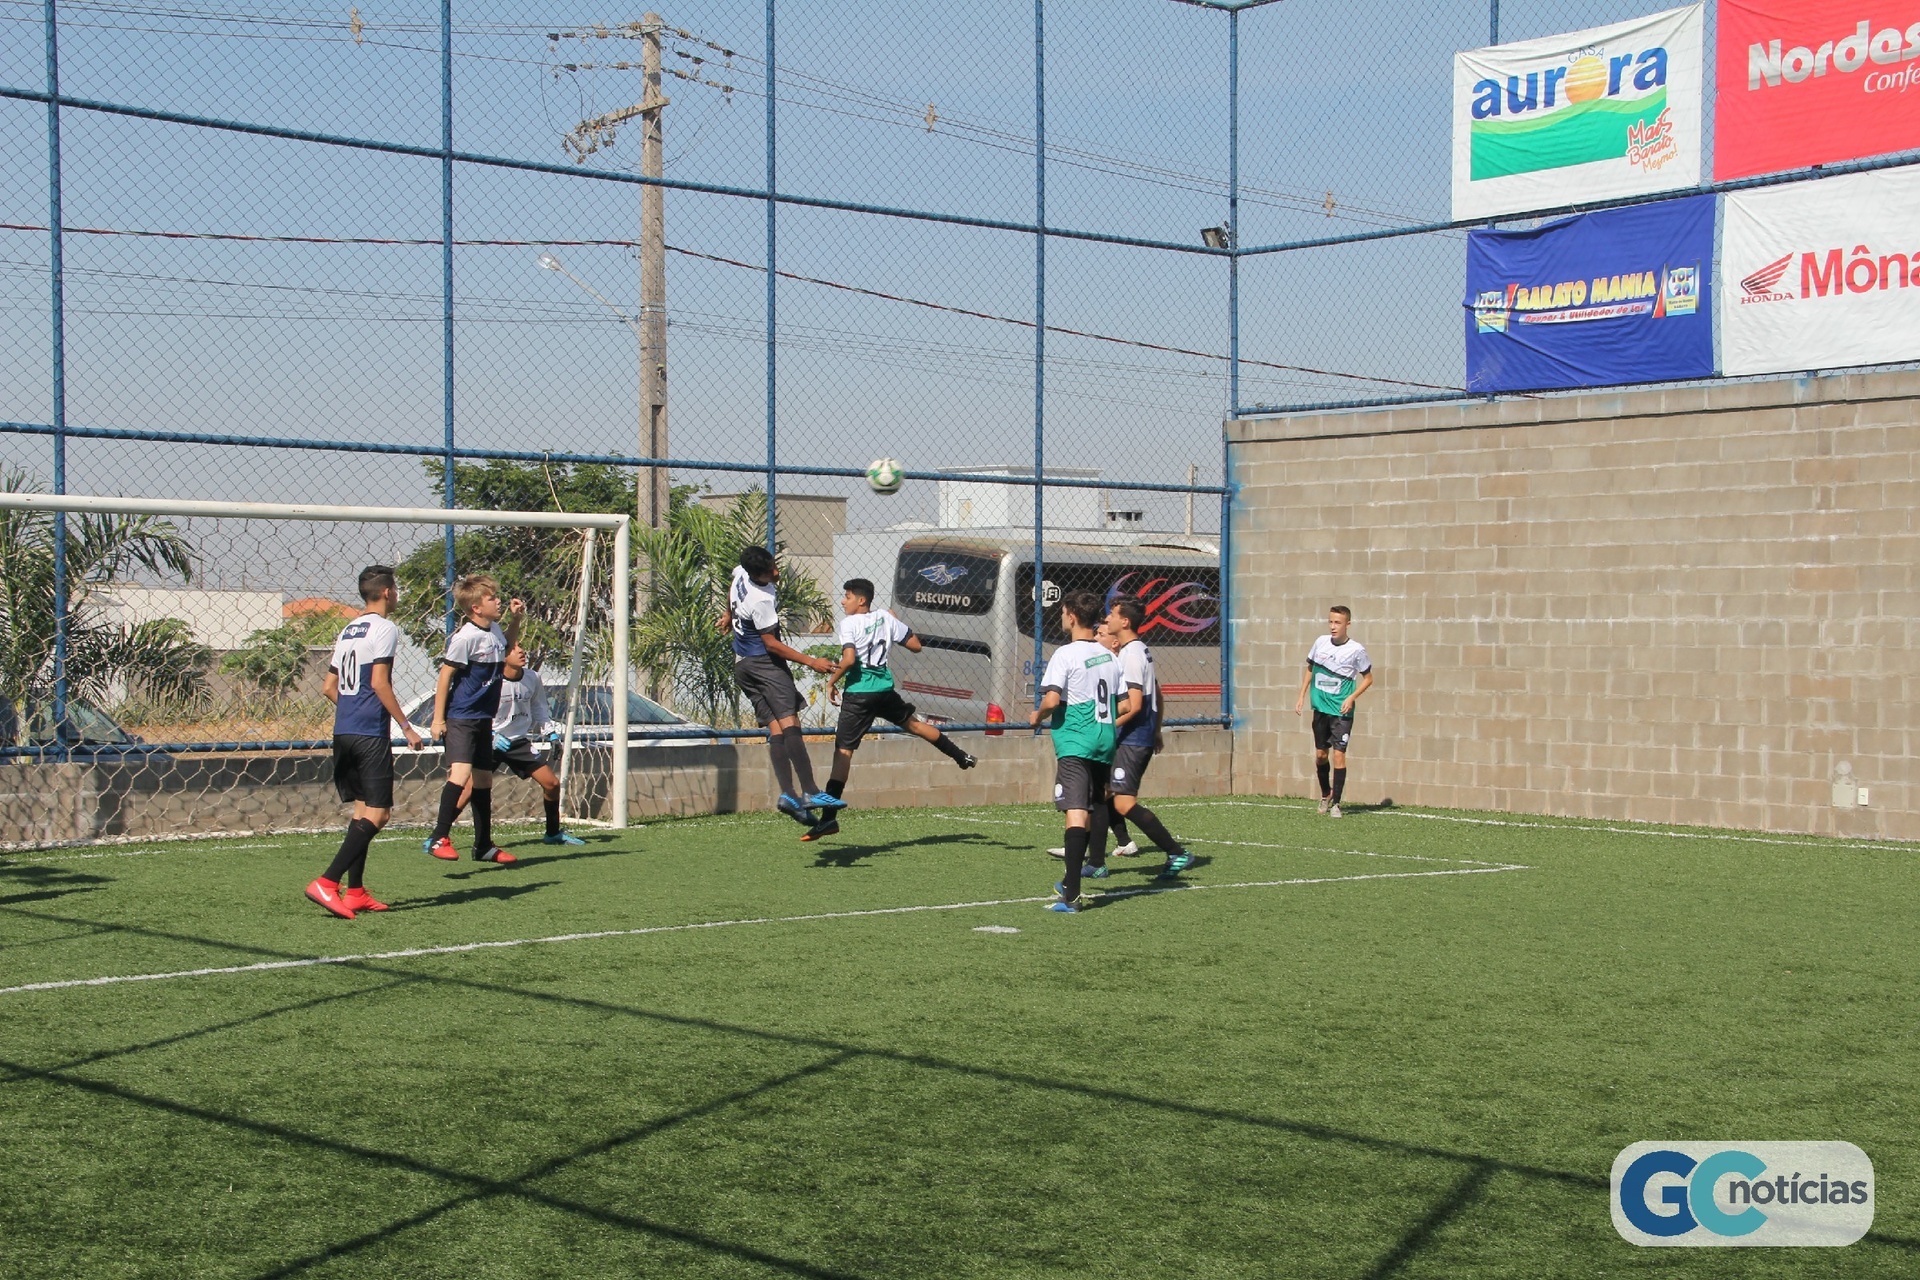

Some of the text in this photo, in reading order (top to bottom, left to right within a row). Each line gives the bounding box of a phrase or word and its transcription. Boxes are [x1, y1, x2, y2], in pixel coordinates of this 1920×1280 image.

[1568, 44, 1605, 64] CASA
[1471, 47, 1668, 120] aurora
[1628, 107, 1673, 147] Mais
[1626, 134, 1674, 166] Barato
[1670, 267, 1695, 284] TOP
[1481, 292, 1503, 306] TOP
[1515, 271, 1657, 311] BARATO MANIA
[1673, 283, 1690, 296] 20
[1740, 292, 1795, 305] HONDA
[915, 591, 971, 607] EXECUTIVO
[1097, 678, 1108, 719] 9
